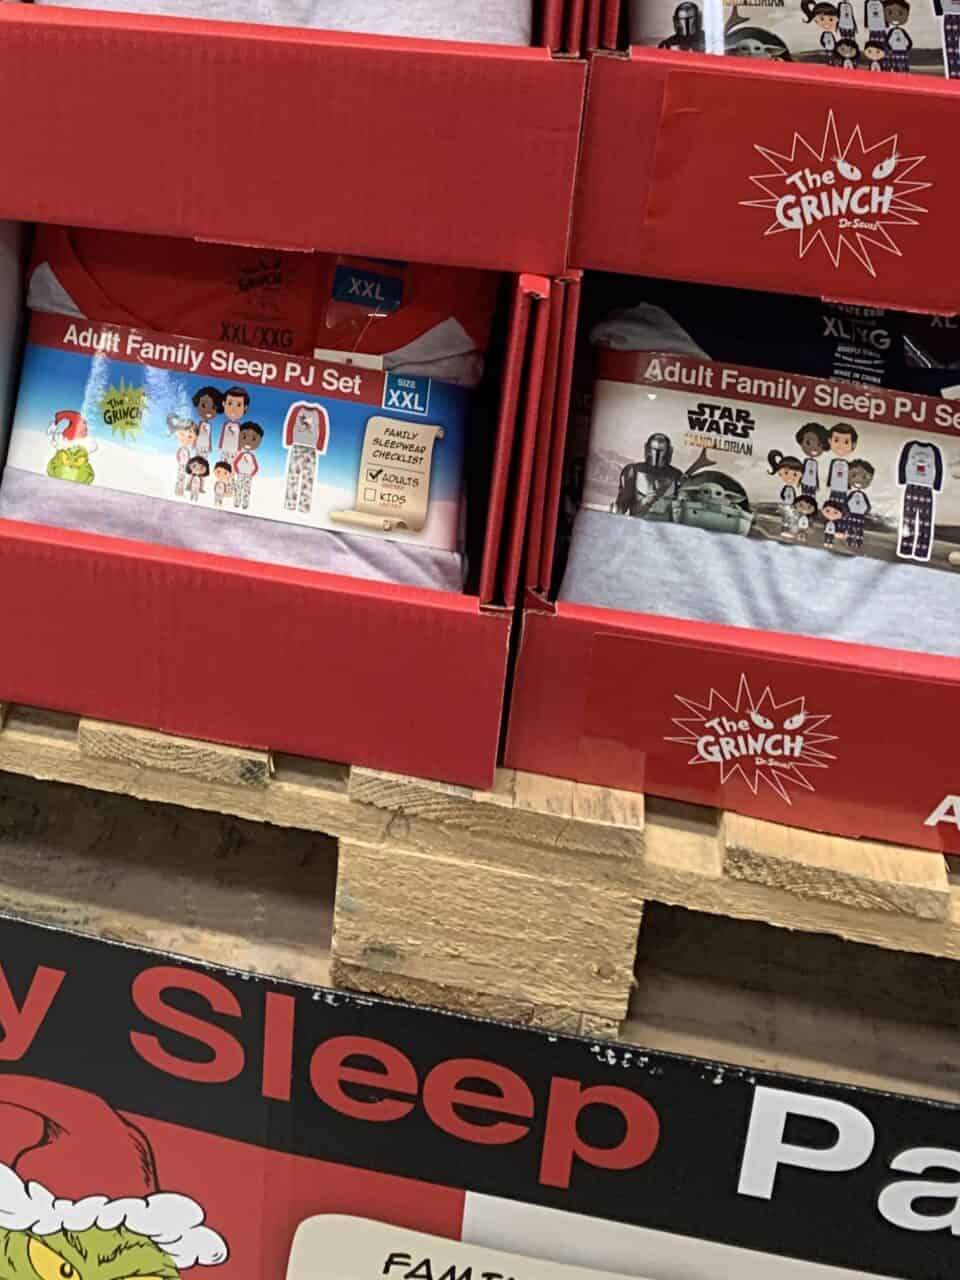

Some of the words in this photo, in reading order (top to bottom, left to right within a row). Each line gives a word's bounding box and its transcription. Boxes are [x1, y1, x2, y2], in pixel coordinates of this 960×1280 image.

[785, 167, 835, 195] The
[774, 185, 894, 230] GRINCH
[349, 277, 385, 301] XXL
[63, 325, 120, 354] Adult
[126, 335, 204, 371] Family
[210, 350, 279, 386] Sleep
[285, 363, 315, 388] PJ
[322, 368, 362, 396] Set
[397, 378, 416, 389] SIZE
[644, 359, 713, 389] Adult
[720, 368, 807, 406] Family
[814, 384, 887, 420] Sleep
[894, 396, 928, 423] PJ
[387, 388, 424, 411] XXL
[102, 399, 145, 426] GRINCH
[687, 403, 755, 424] STAR
[384, 427, 418, 440] FAMILY
[687, 418, 755, 439] WARS
[372, 437, 426, 454] SLEEPWEAR
[372, 449, 424, 465] CHECKLIST
[382, 471, 419, 488] ADULTS
[379, 492, 407, 504] KIDS
[704, 717, 750, 737] The
[696, 732, 805, 762] GRINCH
[127, 964, 662, 1190] Sleep
